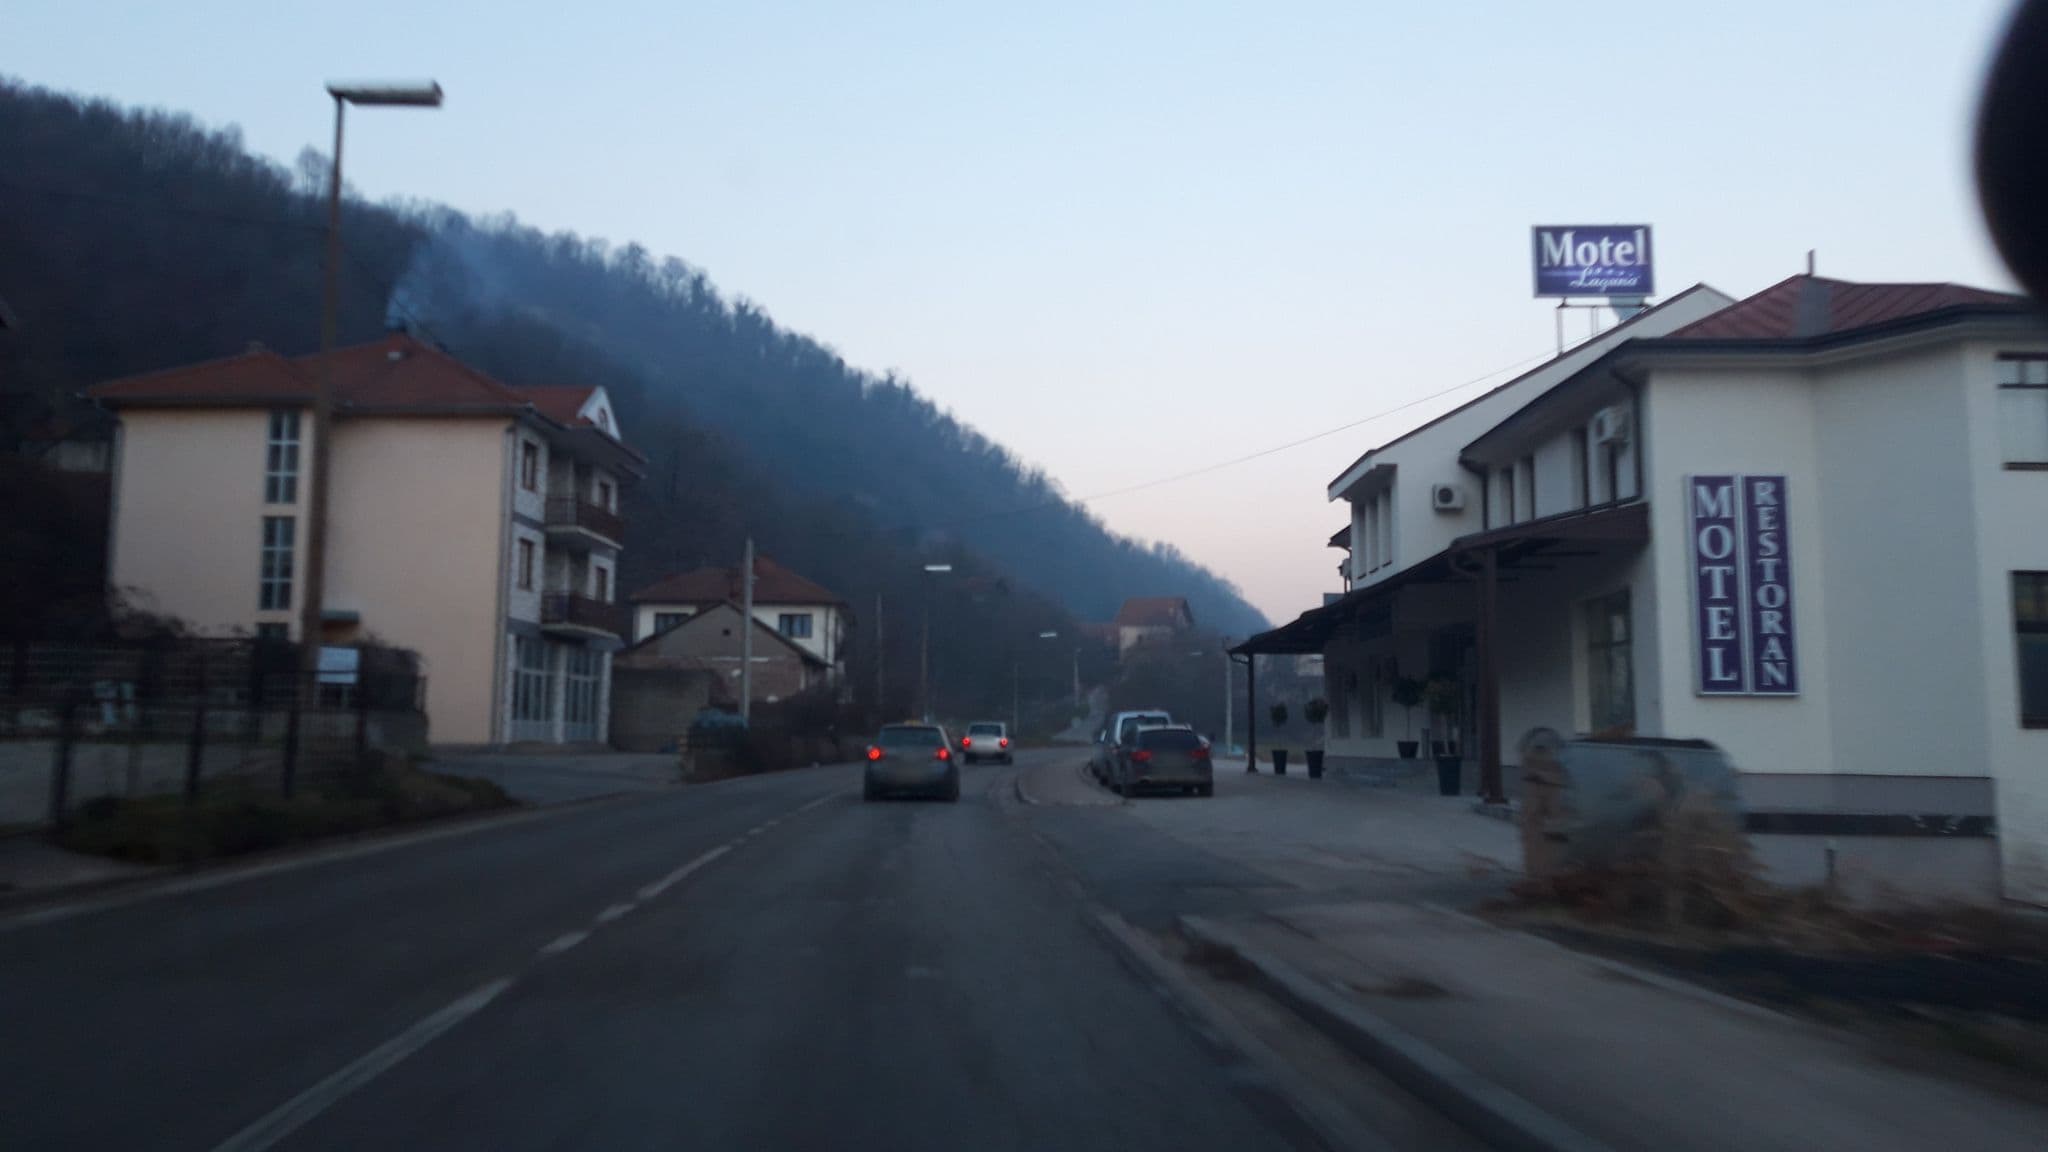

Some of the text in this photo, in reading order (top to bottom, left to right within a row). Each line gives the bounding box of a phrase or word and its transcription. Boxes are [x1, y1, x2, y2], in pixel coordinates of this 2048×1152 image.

[1541, 229, 1648, 267] Motel
[1696, 484, 1738, 681] MOTEL
[1753, 481, 1788, 686] RESTORAN
